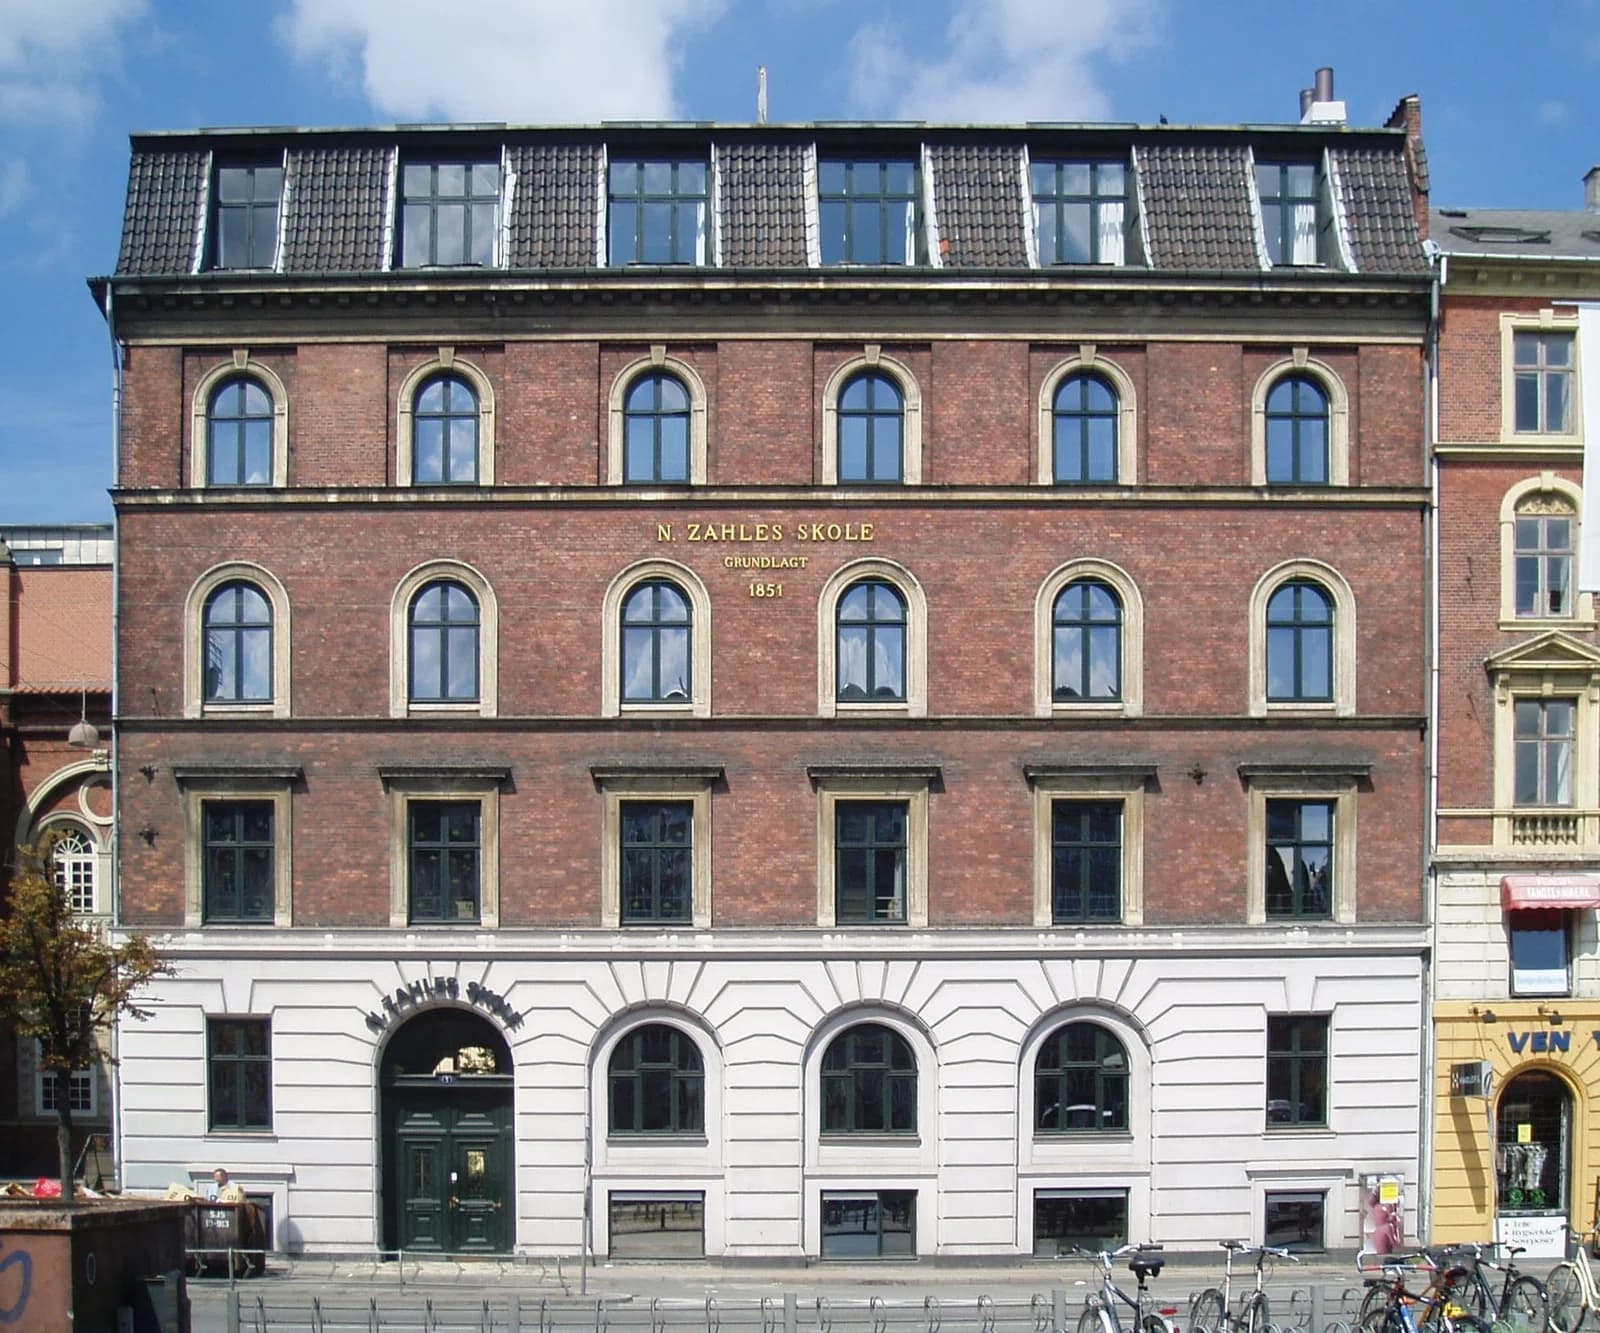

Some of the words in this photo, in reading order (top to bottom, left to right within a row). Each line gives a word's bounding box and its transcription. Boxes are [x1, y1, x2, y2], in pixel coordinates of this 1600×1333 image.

[657, 524, 676, 541] N.
[688, 524, 783, 541] ZAHLES
[798, 524, 874, 541] SKOLE
[724, 557, 808, 568] GRUNDLAGT
[749, 584, 783, 597] 1851
